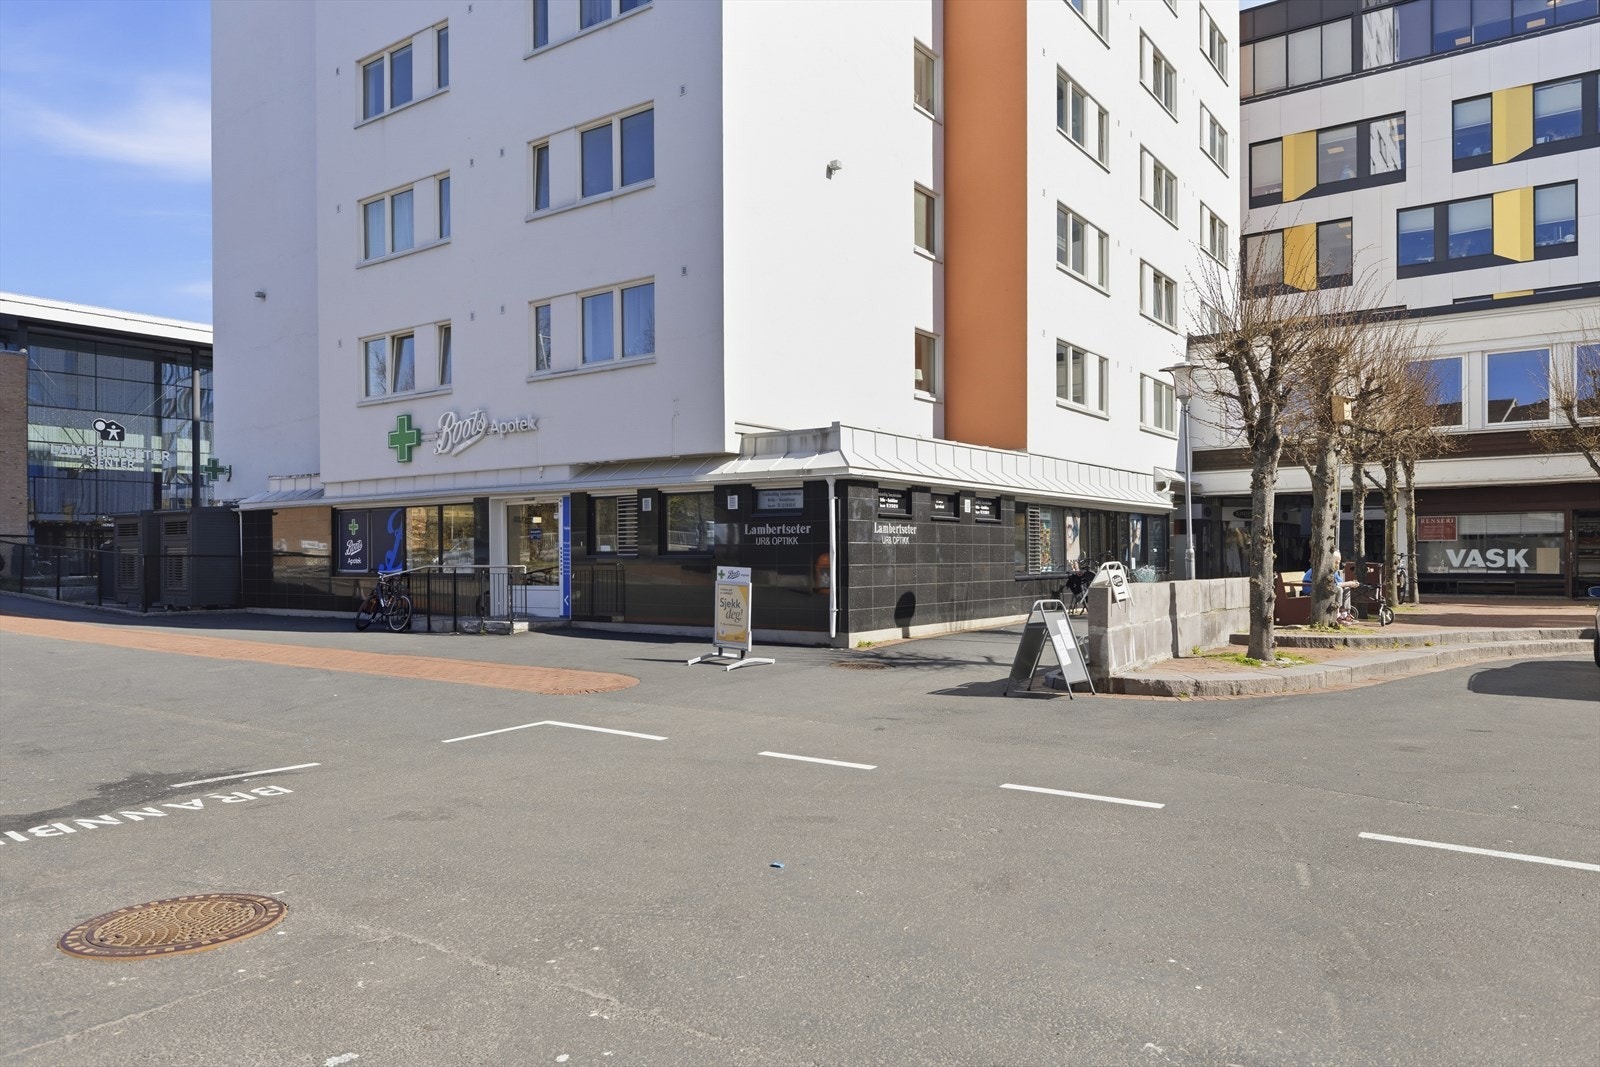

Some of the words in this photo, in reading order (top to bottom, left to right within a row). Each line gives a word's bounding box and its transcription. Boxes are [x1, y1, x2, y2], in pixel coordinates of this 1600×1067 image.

[434, 410, 487, 456] Boots
[490, 416, 538, 438] Apotek
[50, 444, 171, 462] LAMBERTSETER
[90, 458, 135, 469] SENTER
[744, 523, 811, 535] Lambertseter
[874, 522, 918, 535] Lambertseter
[345, 539, 363, 556] Boots
[772, 536, 799, 546] OPTIKK
[892, 536, 910, 545] OPTIKK
[1446, 548, 1529, 567] VASK
[719, 597, 741, 611] Sjekk
[0, 784, 294, 846] BRANNBI
